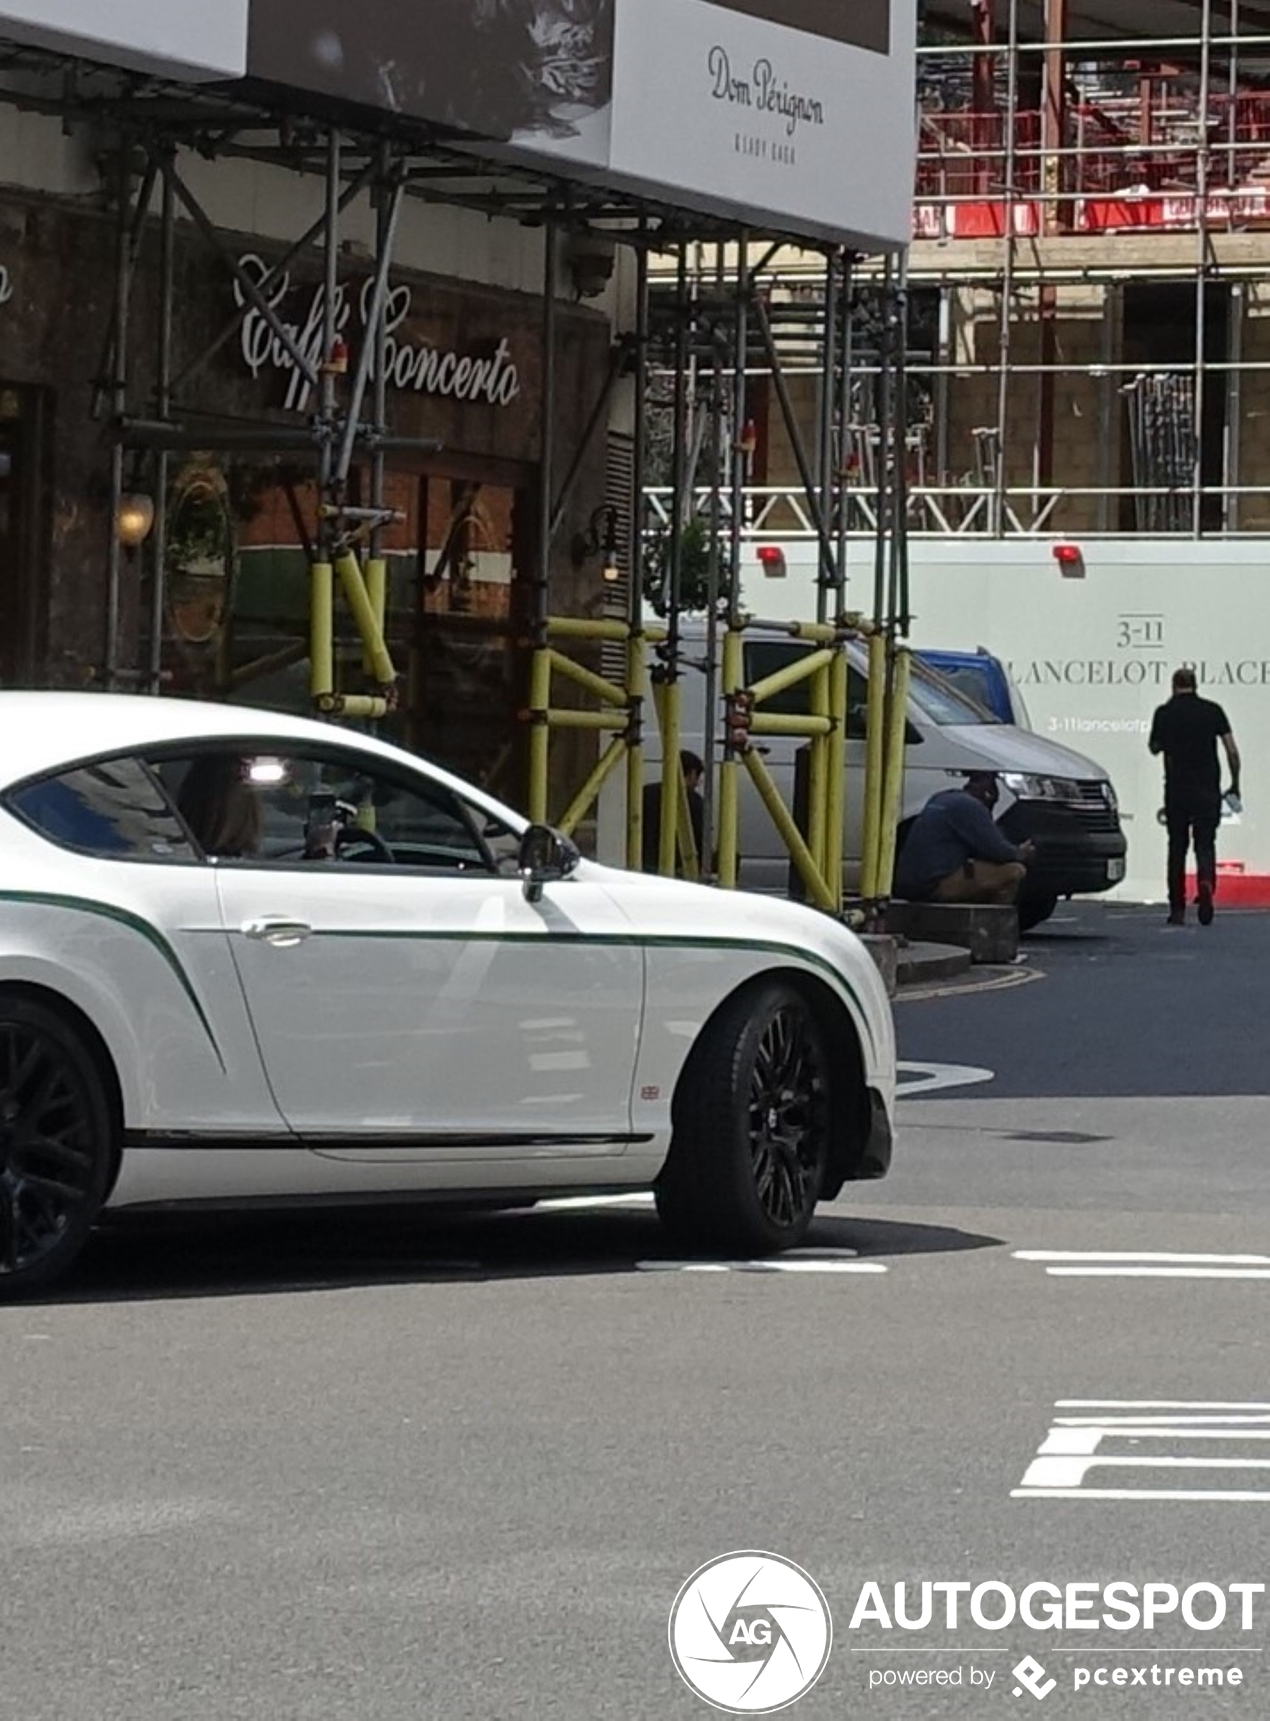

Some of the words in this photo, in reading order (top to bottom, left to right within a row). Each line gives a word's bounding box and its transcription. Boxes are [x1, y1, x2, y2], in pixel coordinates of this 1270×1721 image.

[708, 45, 751, 106] Dom
[753, 58, 823, 136] Pérignon
[1116, 620, 1163, 648] 3-11
